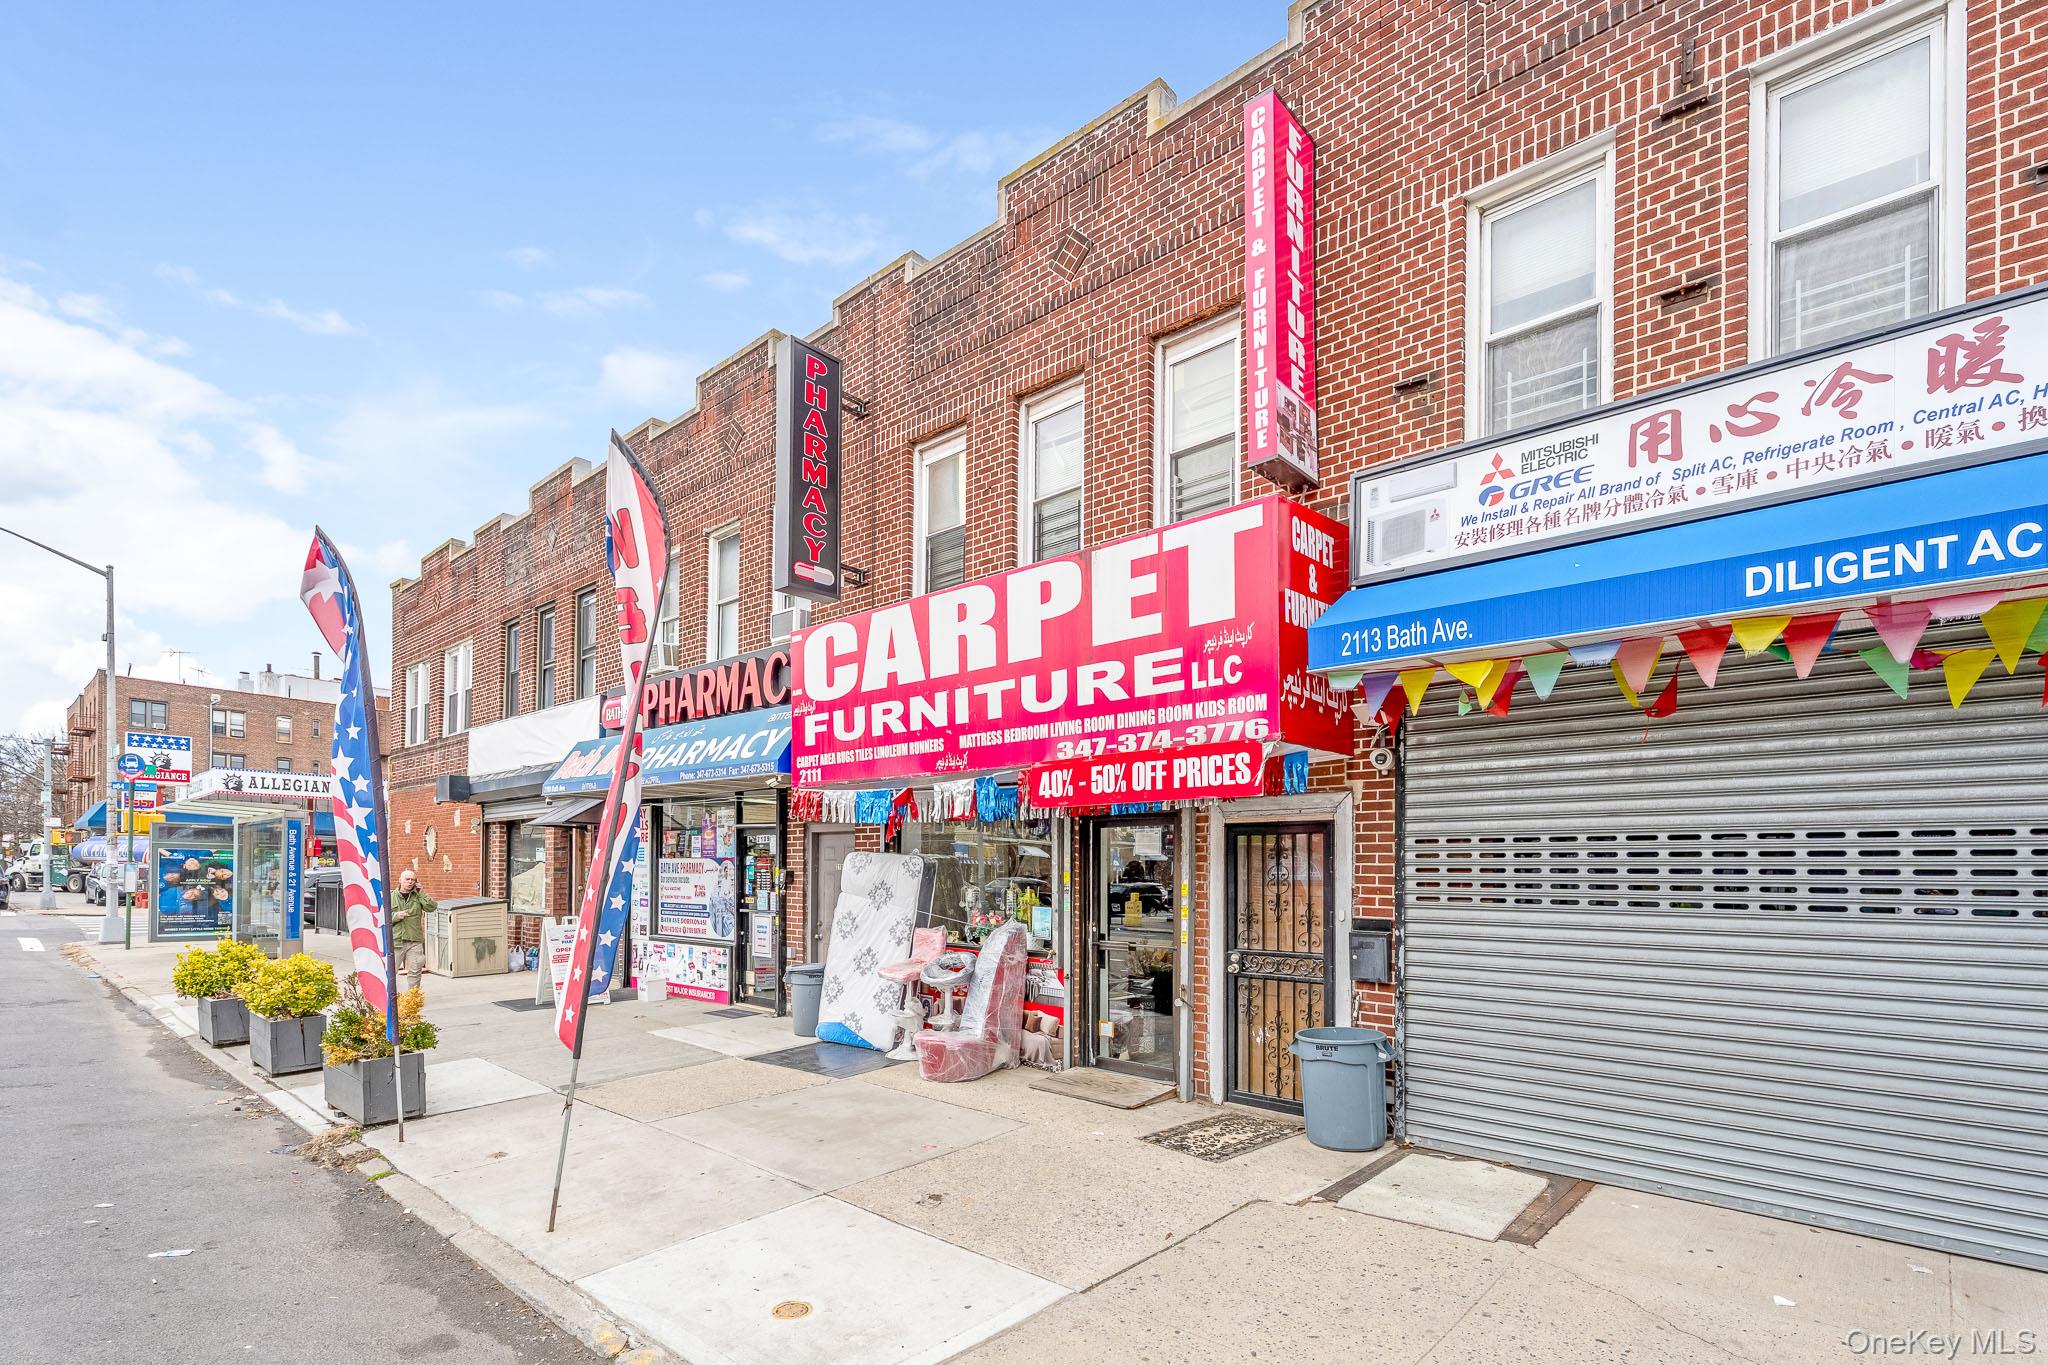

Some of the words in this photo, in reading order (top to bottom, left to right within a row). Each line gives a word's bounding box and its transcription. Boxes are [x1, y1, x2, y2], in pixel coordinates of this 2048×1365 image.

[1251, 106, 1266, 228] CARPET
[1251, 238, 1266, 257] &
[1286, 121, 1306, 399] FURNITURE
[1252, 267, 1268, 450] FURNITURE
[803, 353, 828, 563] PHARMACY
[1461, 515, 1478, 527] We
[1481, 505, 1517, 523] Install
[1521, 501, 1529, 513] &
[1533, 492, 1575, 512] Repair
[1577, 487, 1596, 504] All
[1600, 476, 1641, 496] Brand
[1645, 472, 1662, 487] of
[1671, 462, 1706, 482] Split
[1709, 456, 1737, 473] AC,
[1742, 435, 1835, 466] Refrigerate
[1840, 420, 1894, 442] Room
[1913, 397, 1984, 424] Central
[1988, 389, 2025, 409] AC,
[1521, 433, 1599, 463] MITSUBISHI
[1521, 448, 1588, 475] ELECTRIC
[1509, 464, 1595, 500] GREE
[1291, 515, 1335, 569] CARPET
[1745, 534, 1959, 597] DILIGENT
[1966, 522, 2043, 566] AC
[1308, 564, 1318, 594] &
[802, 505, 1263, 702] CARPET
[1284, 587, 1331, 629] FURNIT
[1341, 628, 1382, 656] 2113
[1387, 621, 1427, 650] Bath
[1431, 617, 1473, 644] Ave.
[643, 651, 788, 728] PHARMAC
[803, 648, 1185, 746] FURNITURE
[1191, 656, 1243, 690] LLC
[606, 706, 623, 721] BATH
[959, 730, 1002, 749] MATTRESS
[1004, 723, 1048, 744] BEDROOM
[1050, 719, 1082, 738] LIVING
[1084, 714, 1115, 734] ROOM
[1117, 709, 1155, 729] DINING
[1158, 703, 1193, 723] ROOM
[1195, 698, 1225, 720] KIDS
[1228, 693, 1267, 714] ROOM
[642, 726, 790, 770] PHARMACY
[796, 754, 819, 768] CARPET
[820, 753, 836, 766] AREA
[836, 751, 854, 764] RUGS
[855, 748, 873, 761] TILES
[874, 743, 908, 759] LINOLEUM
[909, 738, 944, 755] RUNNERS
[1057, 718, 1269, 760] 347-374-3776
[248, 776, 331, 793] ALLEGIAN
[680, 771, 696, 780] Phone:
[800, 768, 821, 783] 2111
[1038, 768, 1074, 799] 40%
[1090, 764, 1126, 795] 50%
[1132, 760, 1167, 791] OFF
[1175, 752, 1251, 788] PRICES
[289, 829, 297, 845] Bath
[289, 846, 297, 870] Avenue
[660, 862, 671, 874] BATH
[680, 862, 704, 874] PHARMACY
[288, 888, 297, 913] Avenue
[674, 986, 688, 996] MAJOR
[688, 989, 715, 1000] INSURANCES
[1315, 1044, 1338, 1052] BRUTE
